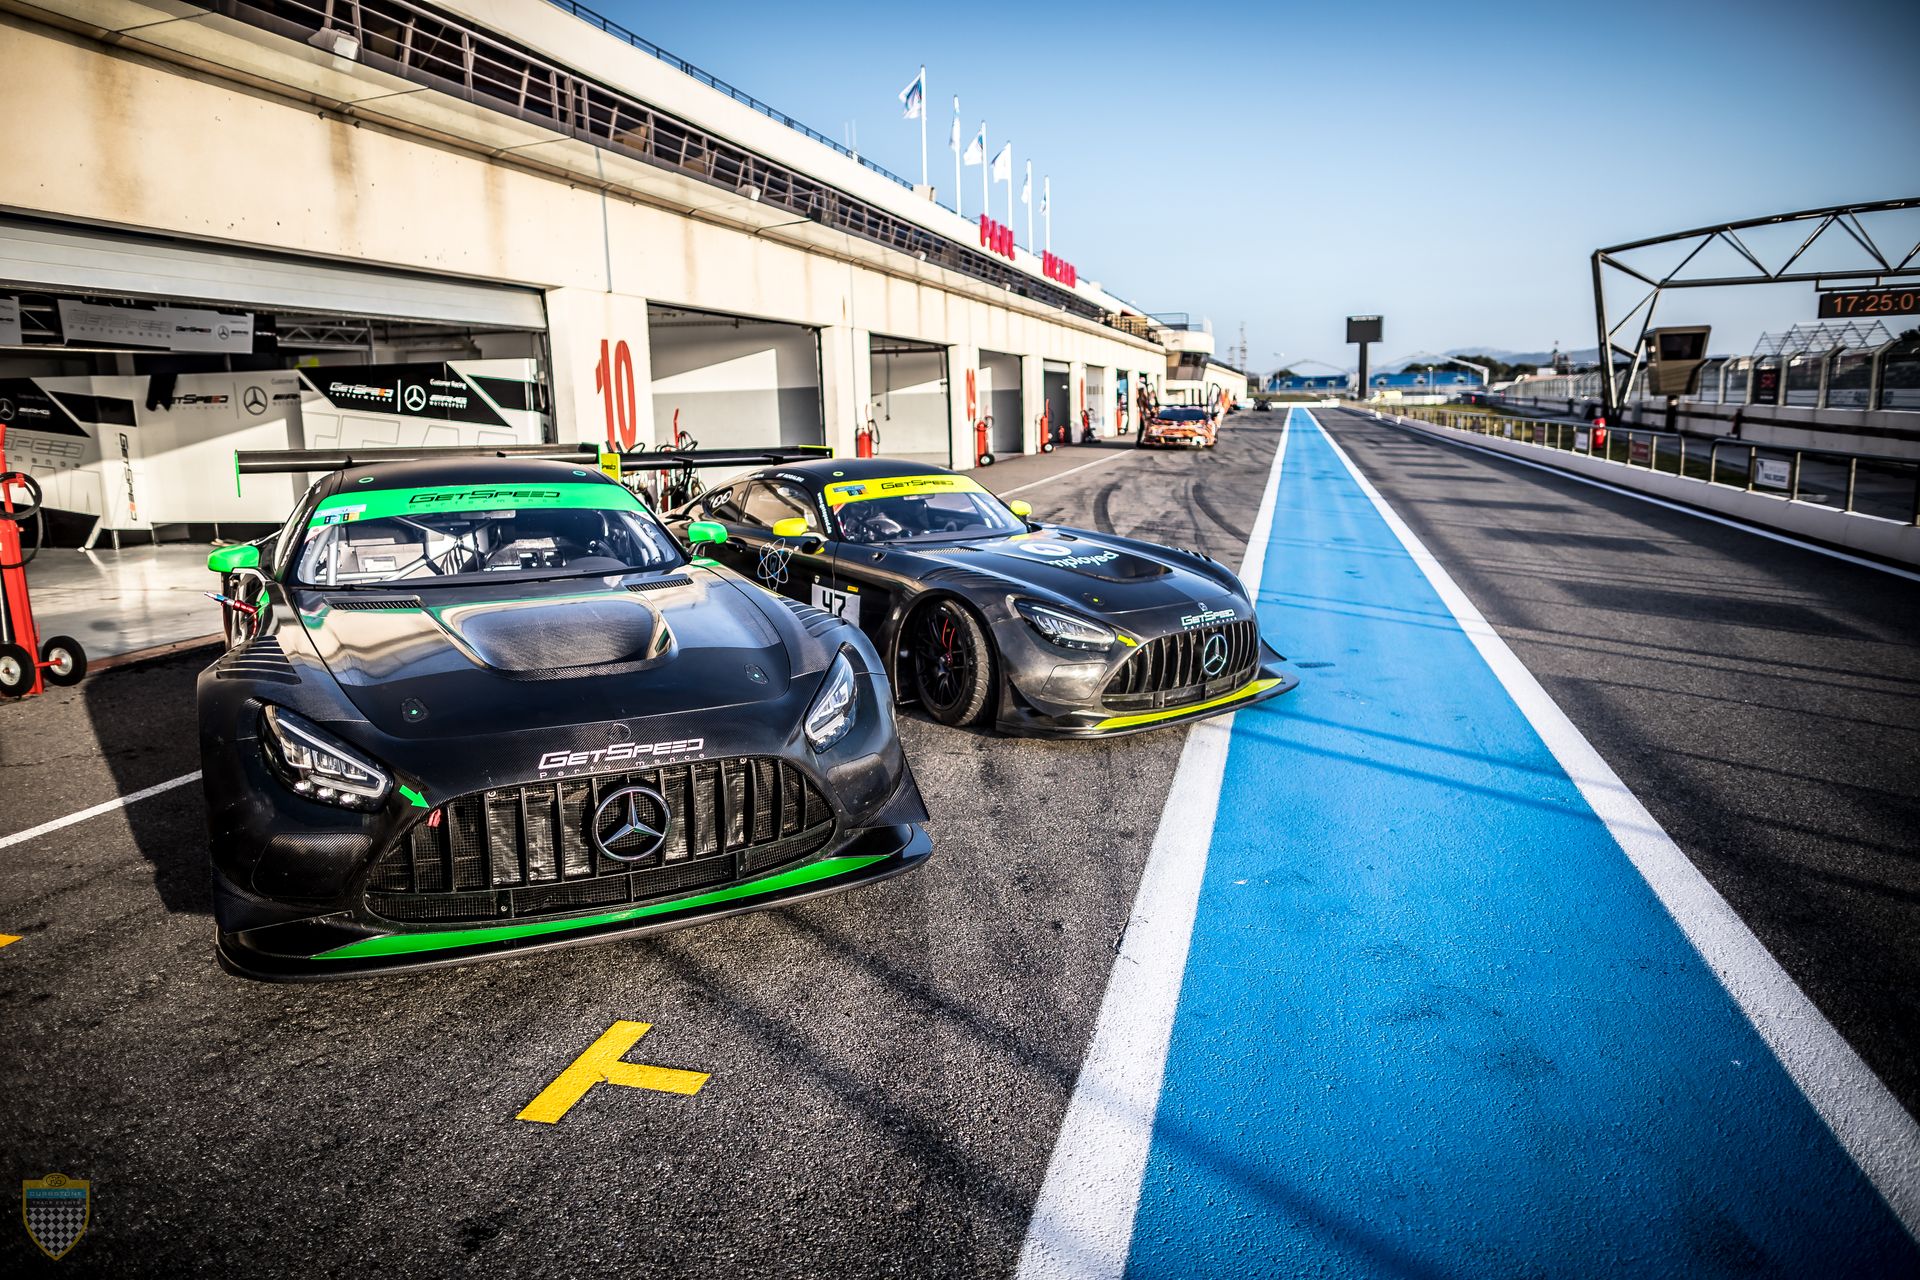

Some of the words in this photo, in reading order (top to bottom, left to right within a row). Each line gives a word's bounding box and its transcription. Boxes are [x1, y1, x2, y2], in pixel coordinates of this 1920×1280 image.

[1833, 293, 1920, 313] 17:25:0
[596, 339, 636, 452] 10
[1047, 550, 1120, 568] mployed
[822, 590, 846, 617] 47
